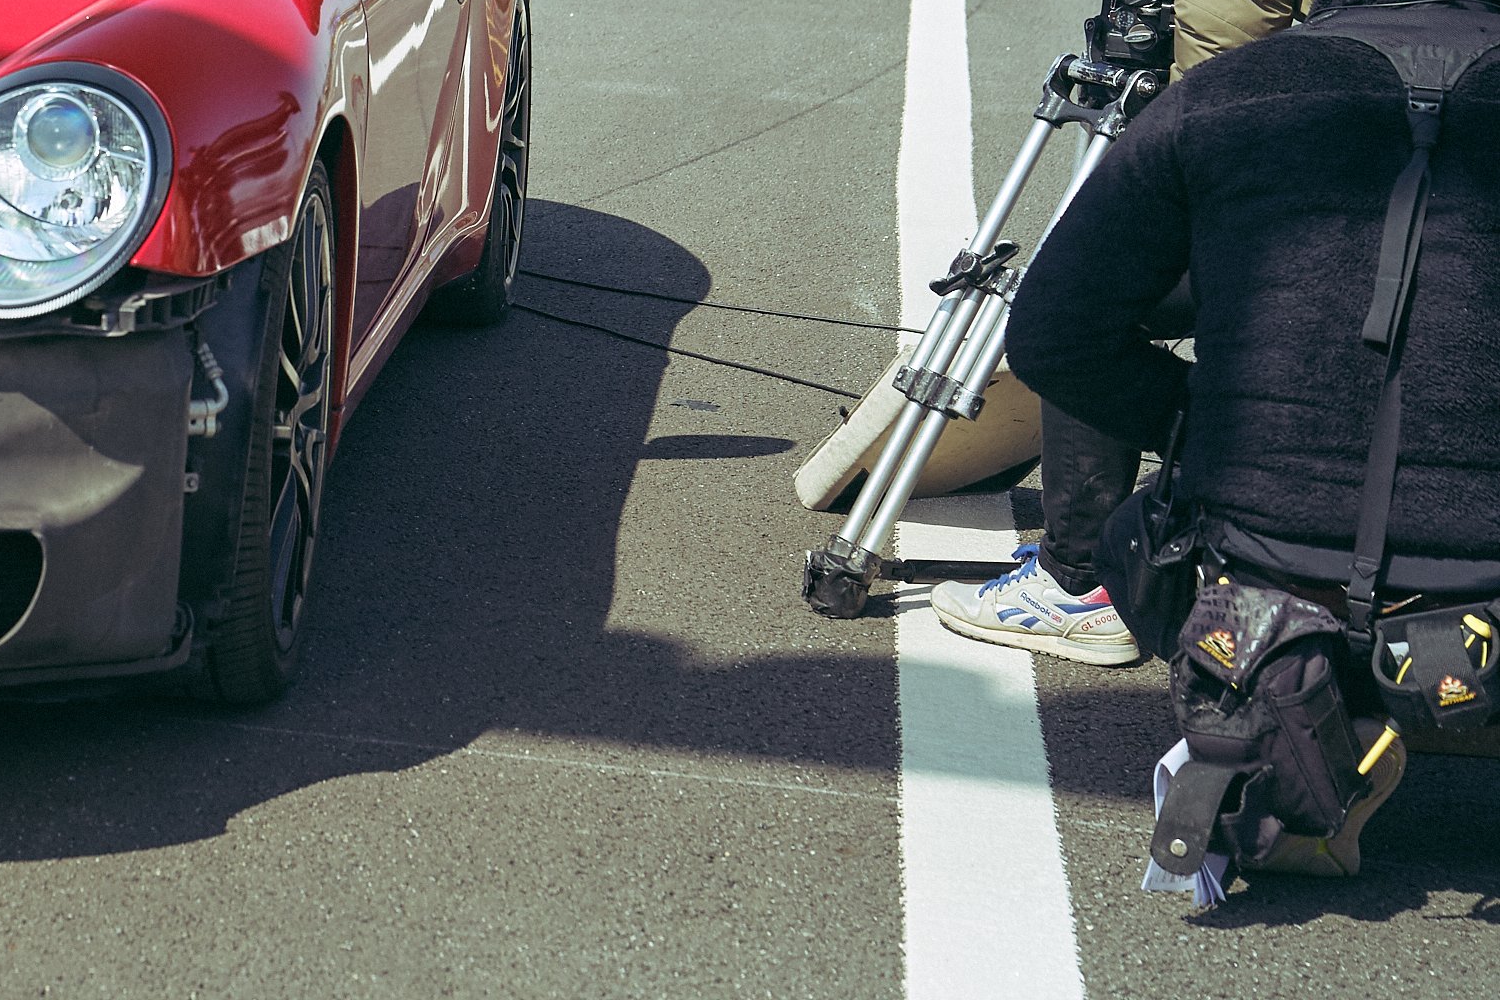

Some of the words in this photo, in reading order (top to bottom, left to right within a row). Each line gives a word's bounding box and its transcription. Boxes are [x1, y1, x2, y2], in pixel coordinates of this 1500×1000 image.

[1019, 592, 1052, 617] Reebok
[1081, 621, 1094, 632] GL
[1094, 613, 1118, 628] 6000
